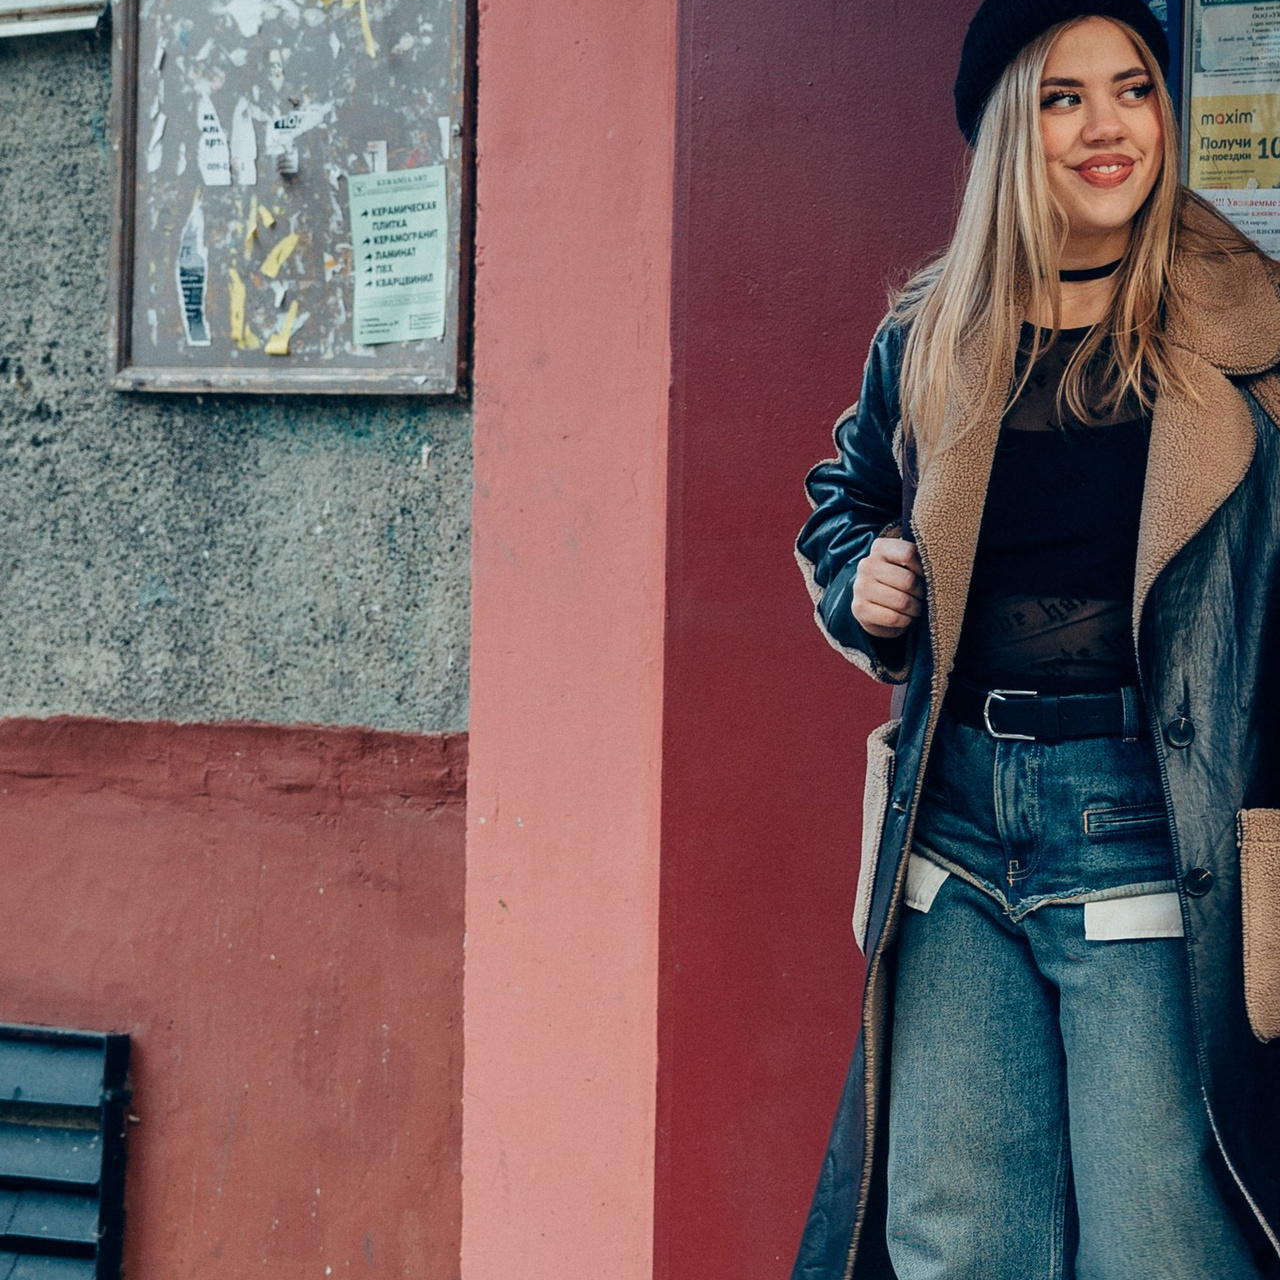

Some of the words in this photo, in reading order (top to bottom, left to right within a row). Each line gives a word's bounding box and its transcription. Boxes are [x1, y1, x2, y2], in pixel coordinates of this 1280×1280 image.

[1201, 109, 1253, 126] maxim
[1200, 137, 1251, 151] Получи
[1212, 153, 1251, 162] поездки
[371, 201, 437, 217] КЕРАМИЧЕСКАЯ
[372, 219, 408, 231] ПЛИТКА
[373, 229, 438, 245] КЕРАМОГРАНИТ
[375, 247, 416, 260] ЛАМИНАТ
